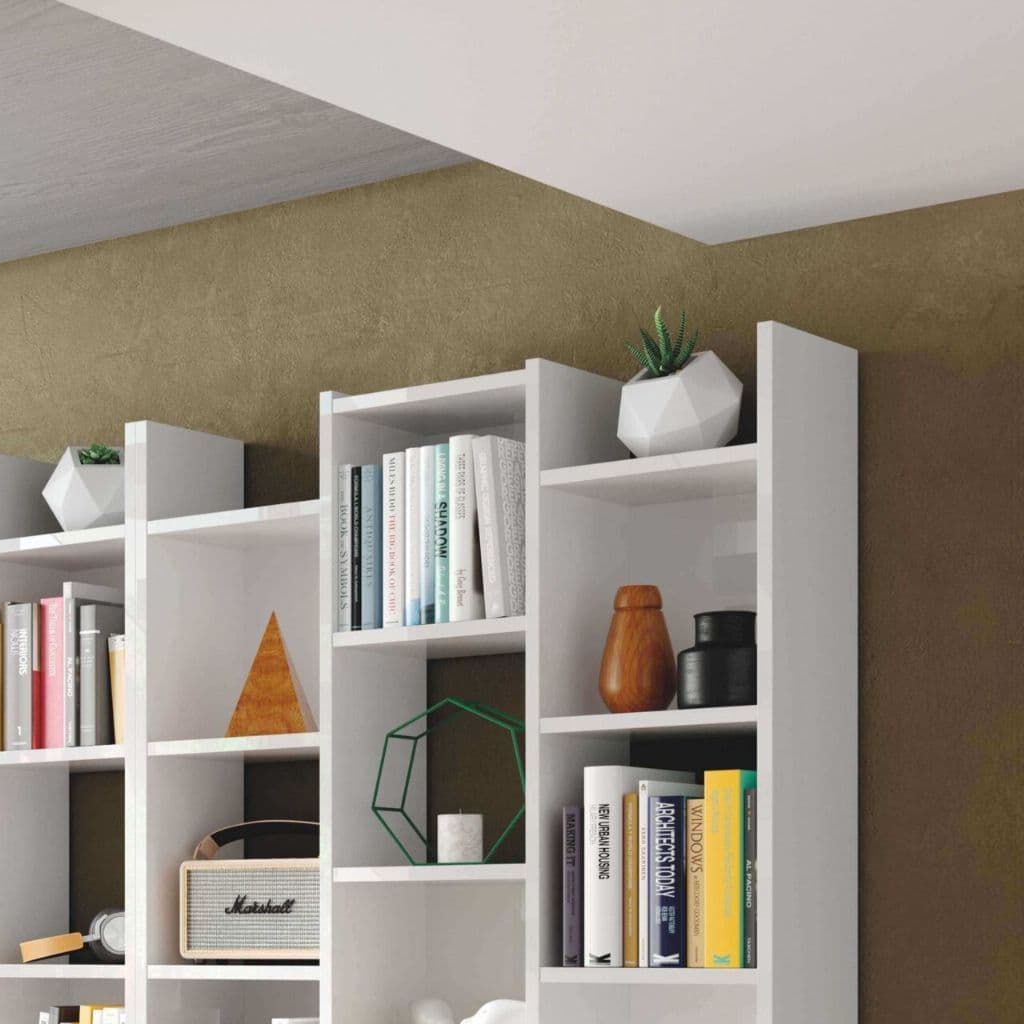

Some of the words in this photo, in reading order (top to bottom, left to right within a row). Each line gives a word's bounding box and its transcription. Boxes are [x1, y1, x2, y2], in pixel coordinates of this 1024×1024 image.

[437, 501, 448, 559] SHADOW
[598, 803, 610, 820] NEW
[565, 813, 577, 853] MAKING
[598, 821, 610, 846] URBAN
[654, 801, 676, 863] ARCHITECTS
[690, 804, 704, 873] WINDOWS
[566, 854, 576, 866] IT
[598, 847, 610, 879] HOUSING
[745, 859, 753, 871] AL
[654, 864, 676, 898] TODAY
[745, 872, 753, 908] PACINO
[225, 894, 296, 914] Marshall
